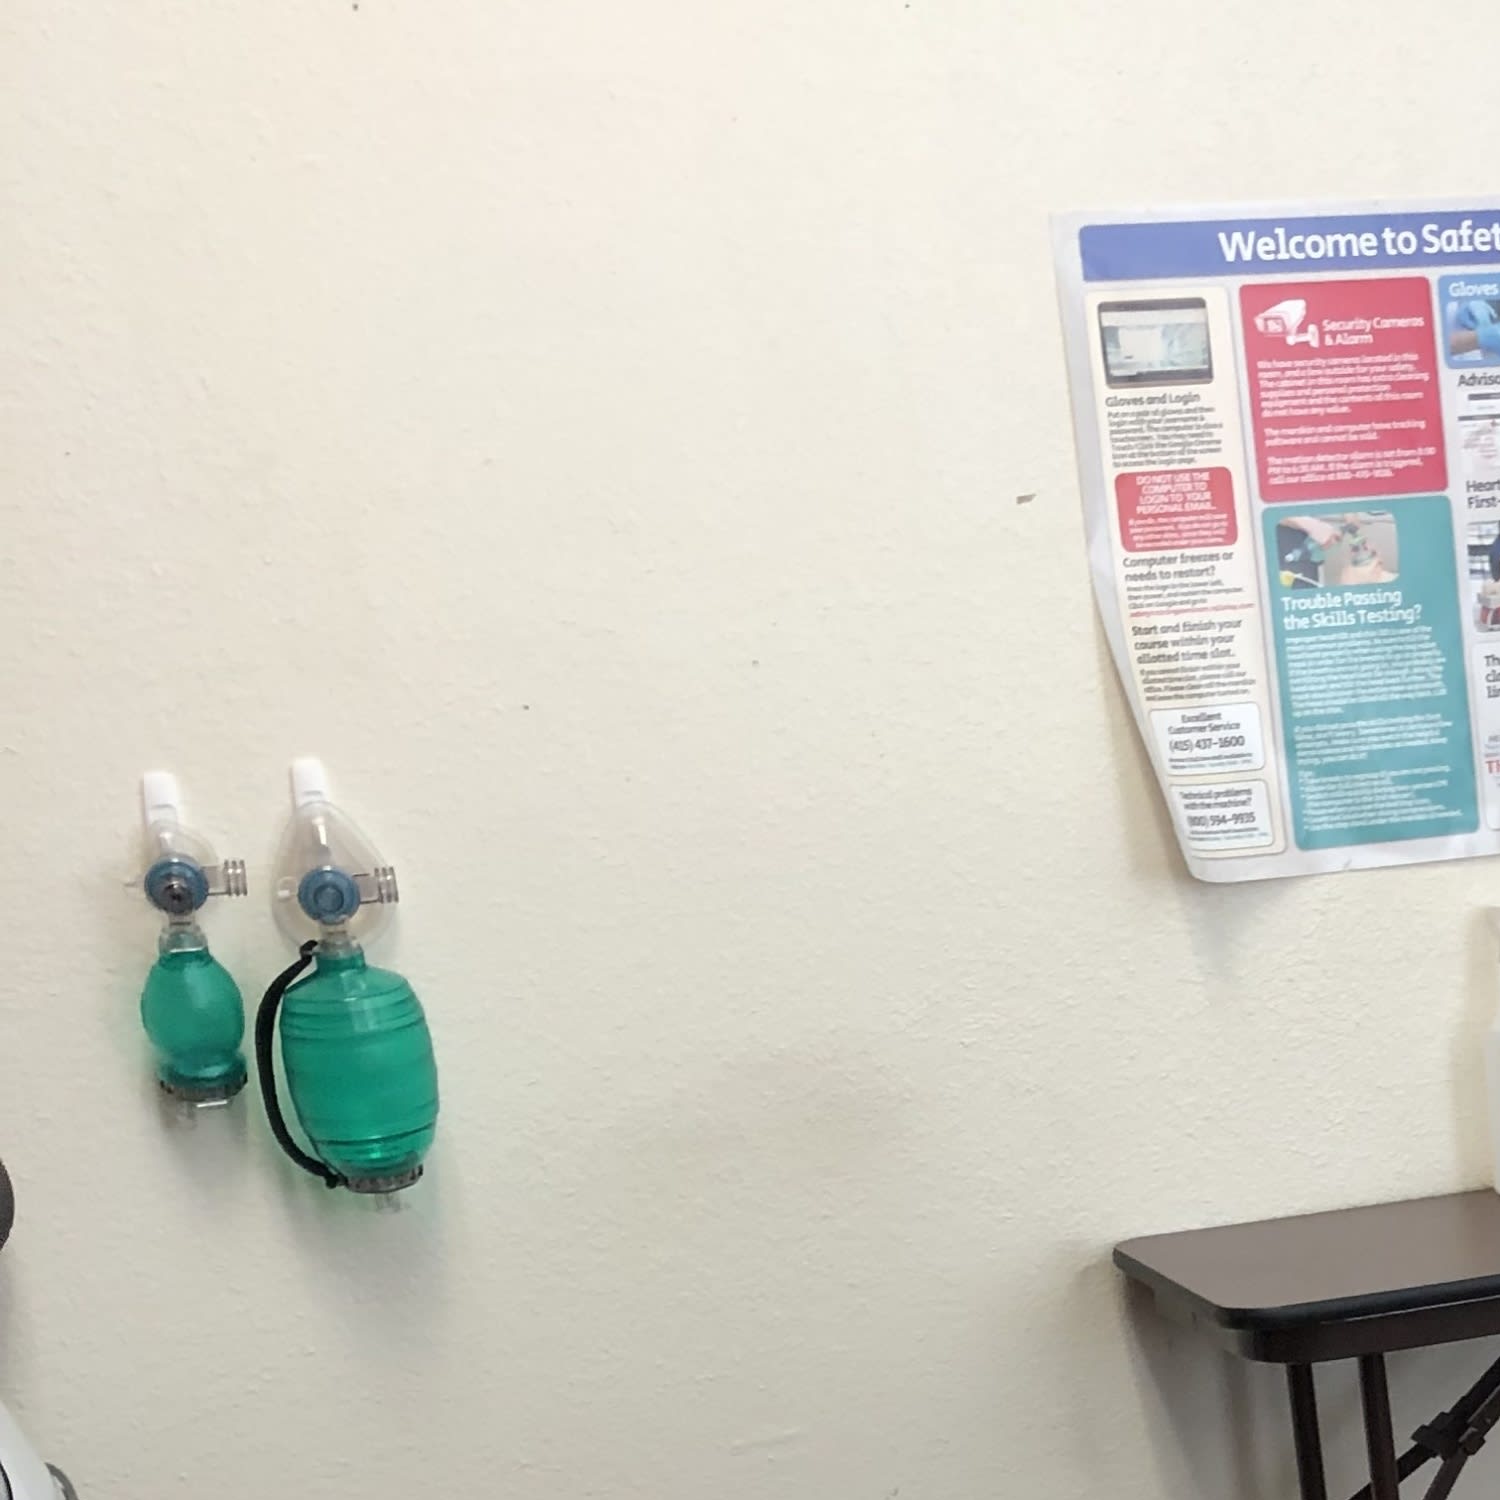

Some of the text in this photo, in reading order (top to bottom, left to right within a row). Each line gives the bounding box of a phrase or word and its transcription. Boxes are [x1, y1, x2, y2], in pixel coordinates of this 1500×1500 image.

[1218, 224, 1377, 262] Welcome
[1383, 225, 1416, 254] to
[1448, 281, 1499, 297] Gloves
[1322, 316, 1424, 334] Security Cameras
[1324, 334, 1372, 346] & Alarm
[1105, 392, 1200, 407] Gloves and Login
[1122, 551, 1234, 570] Computer freezes or
[1124, 566, 1216, 582] needs to restart?
[1280, 590, 1402, 611] Trouble Passing
[1283, 605, 1422, 630] the Skills Testing?
[1131, 620, 1242, 636] Start and finish your
[1134, 635, 1235, 650] course within your
[1137, 648, 1236, 664] allotted time slot.
[1180, 712, 1222, 723] Excellent
[1168, 722, 1241, 735] Customer Service
